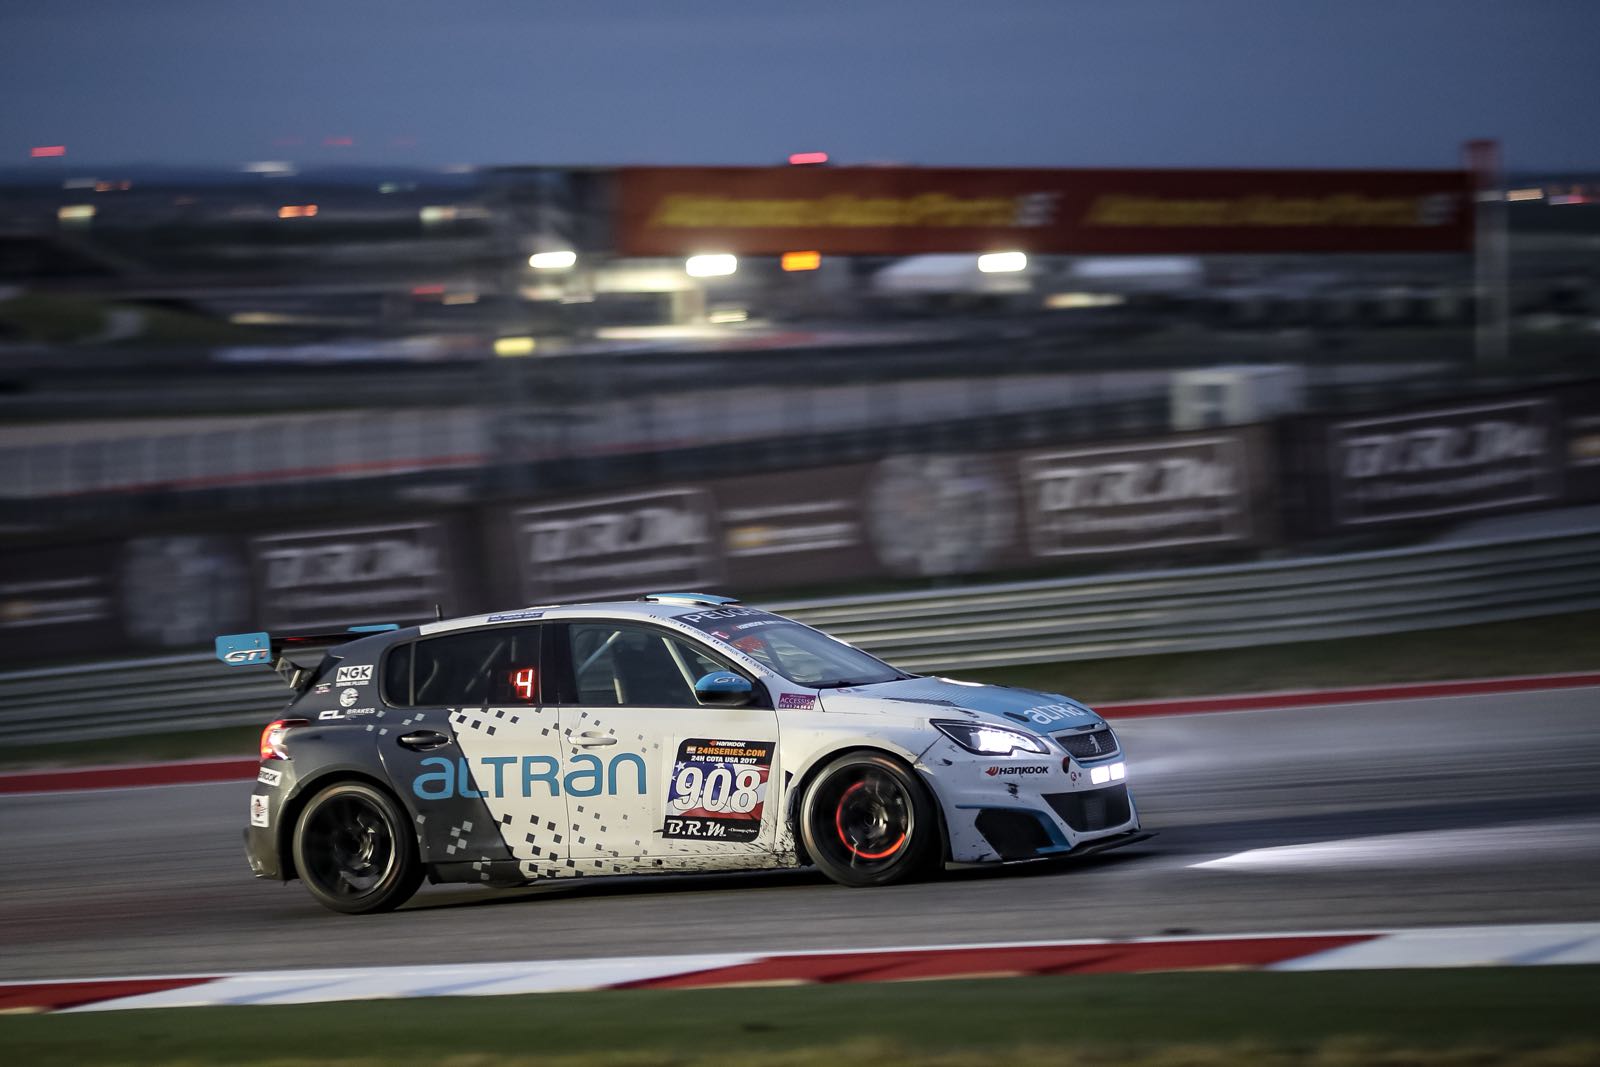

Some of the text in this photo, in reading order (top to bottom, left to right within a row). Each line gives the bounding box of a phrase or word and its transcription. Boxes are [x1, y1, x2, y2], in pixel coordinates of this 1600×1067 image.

[682, 607, 760, 622] PEUG
[338, 665, 371, 680] NGK
[516, 668, 533, 698] 4
[318, 710, 345, 720] CL
[697, 747, 766, 757] 24HSERIES.COM
[673, 766, 761, 814] 908
